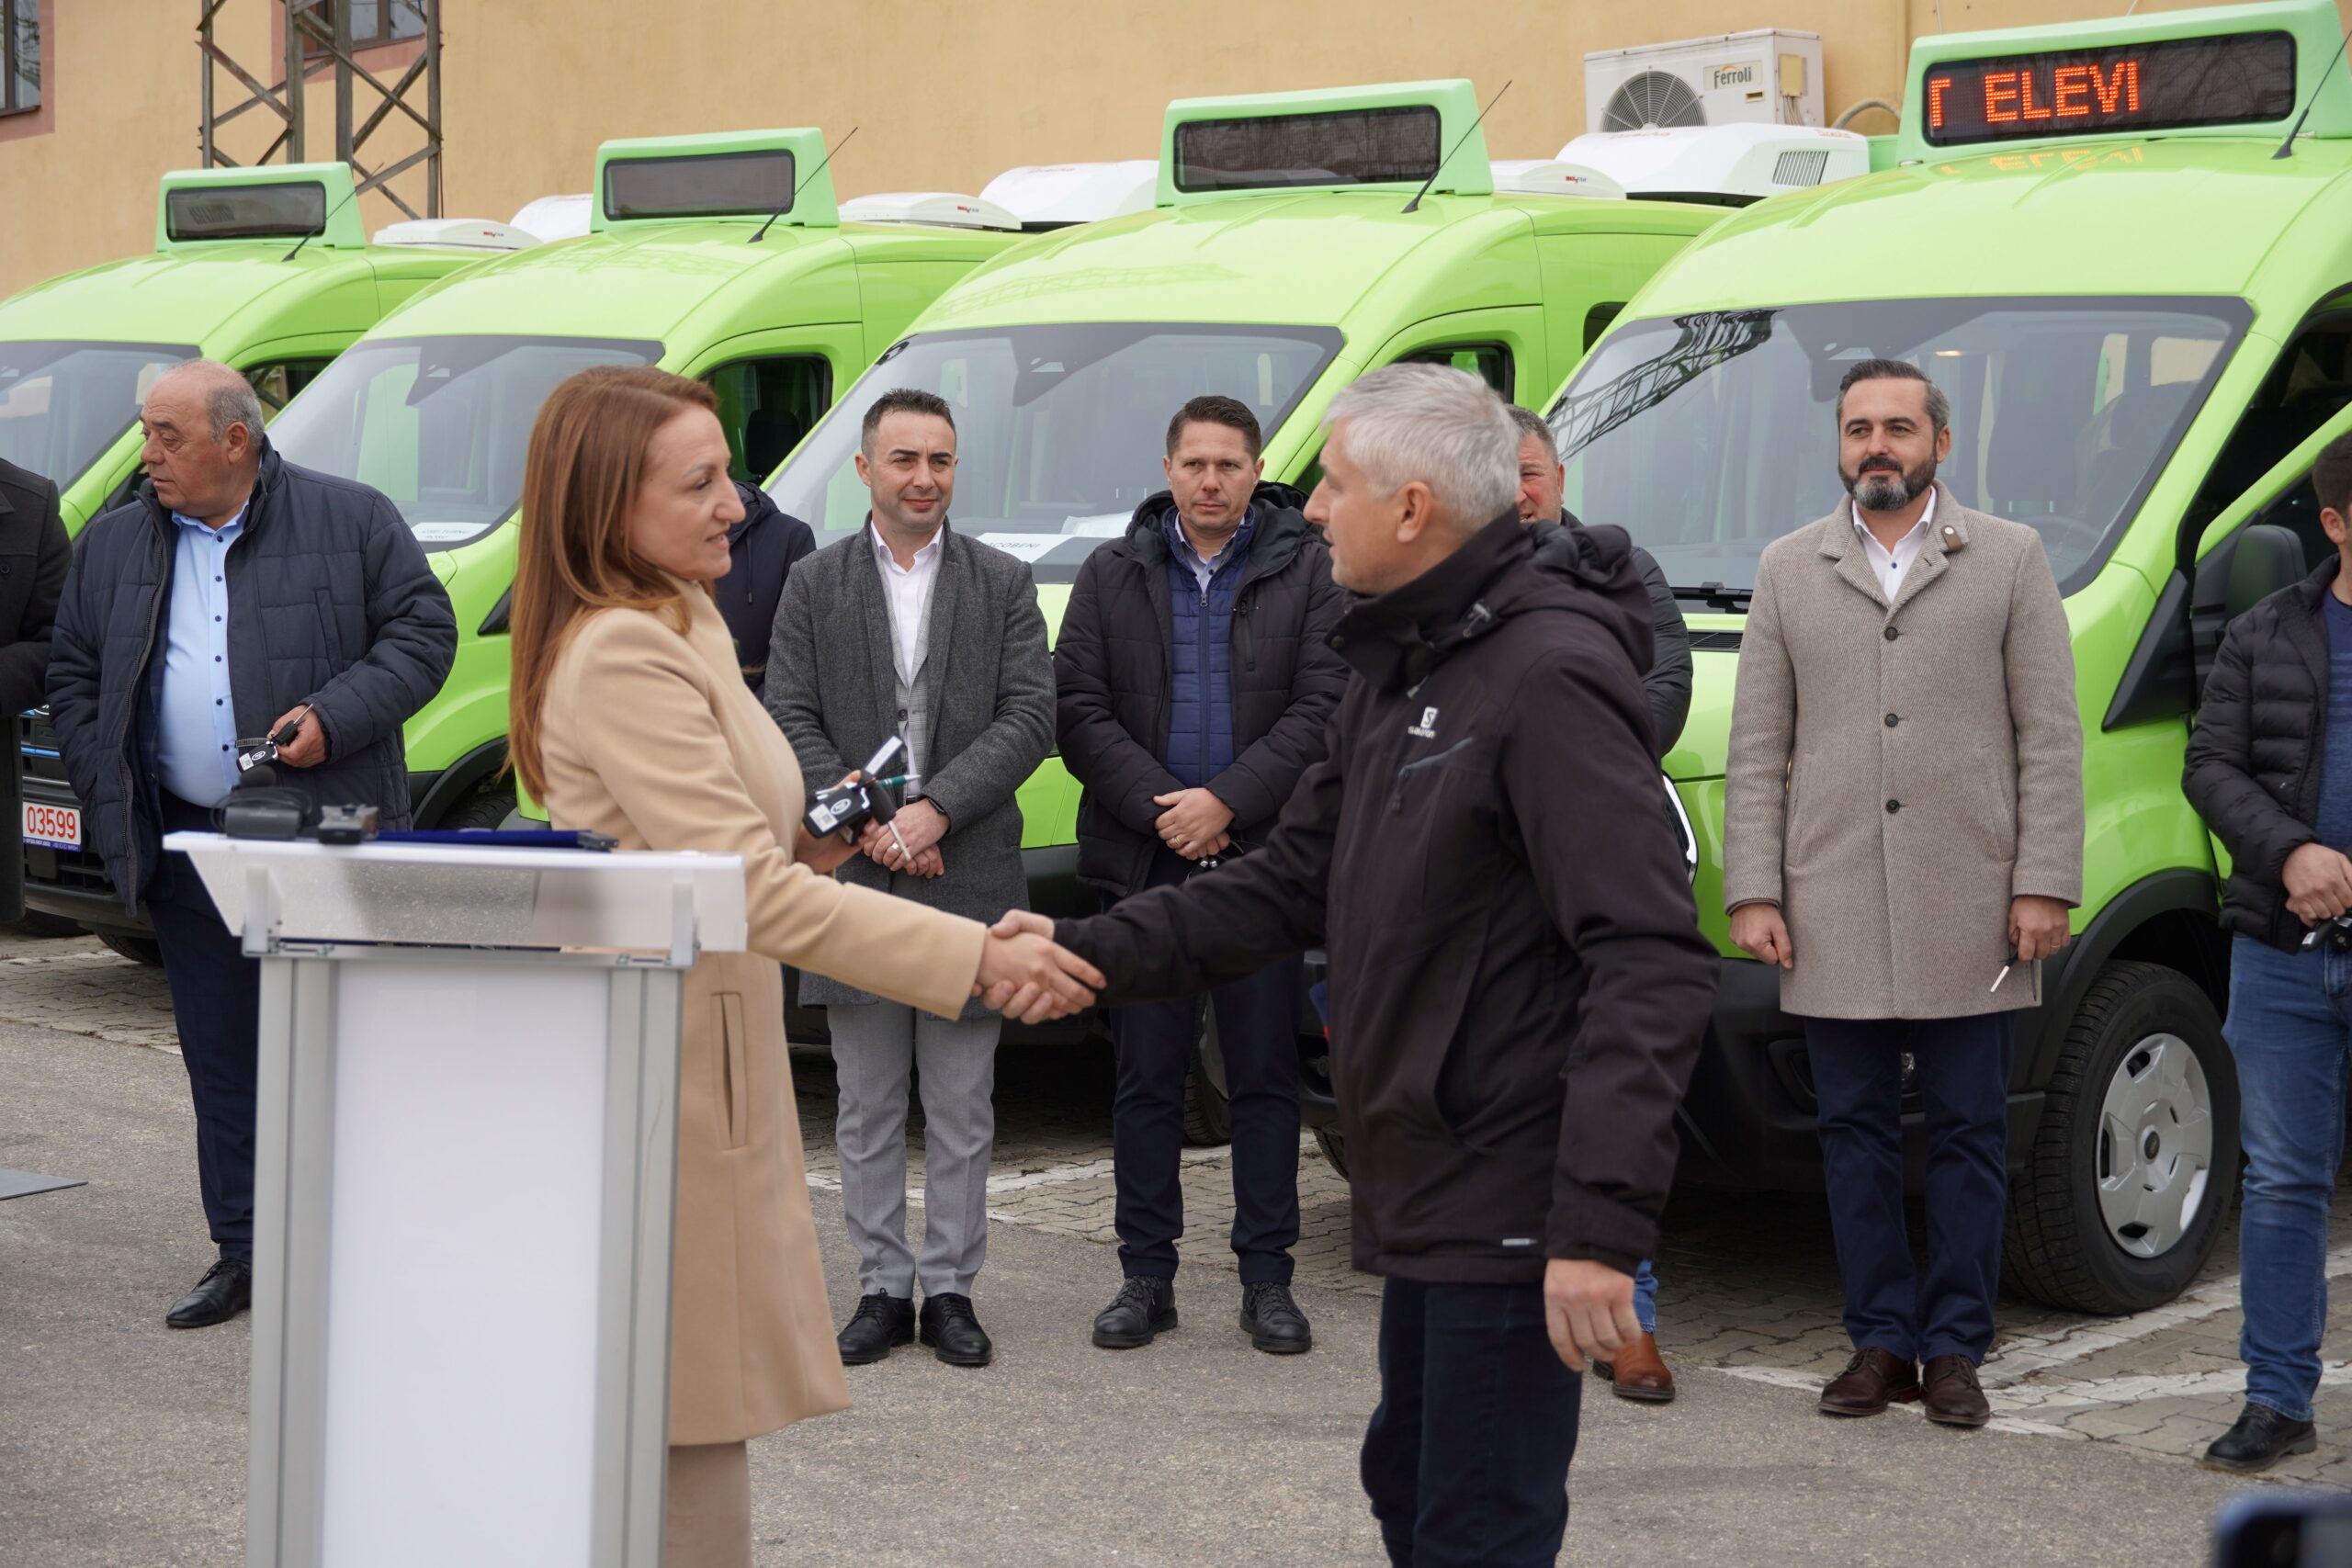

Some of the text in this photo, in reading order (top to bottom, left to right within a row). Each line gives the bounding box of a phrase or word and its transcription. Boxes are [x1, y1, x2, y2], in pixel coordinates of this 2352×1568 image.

[1713, 66, 1752, 89] Ferroli
[1984, 61, 2139, 122] ELEVI
[27, 806, 76, 840] 03599
